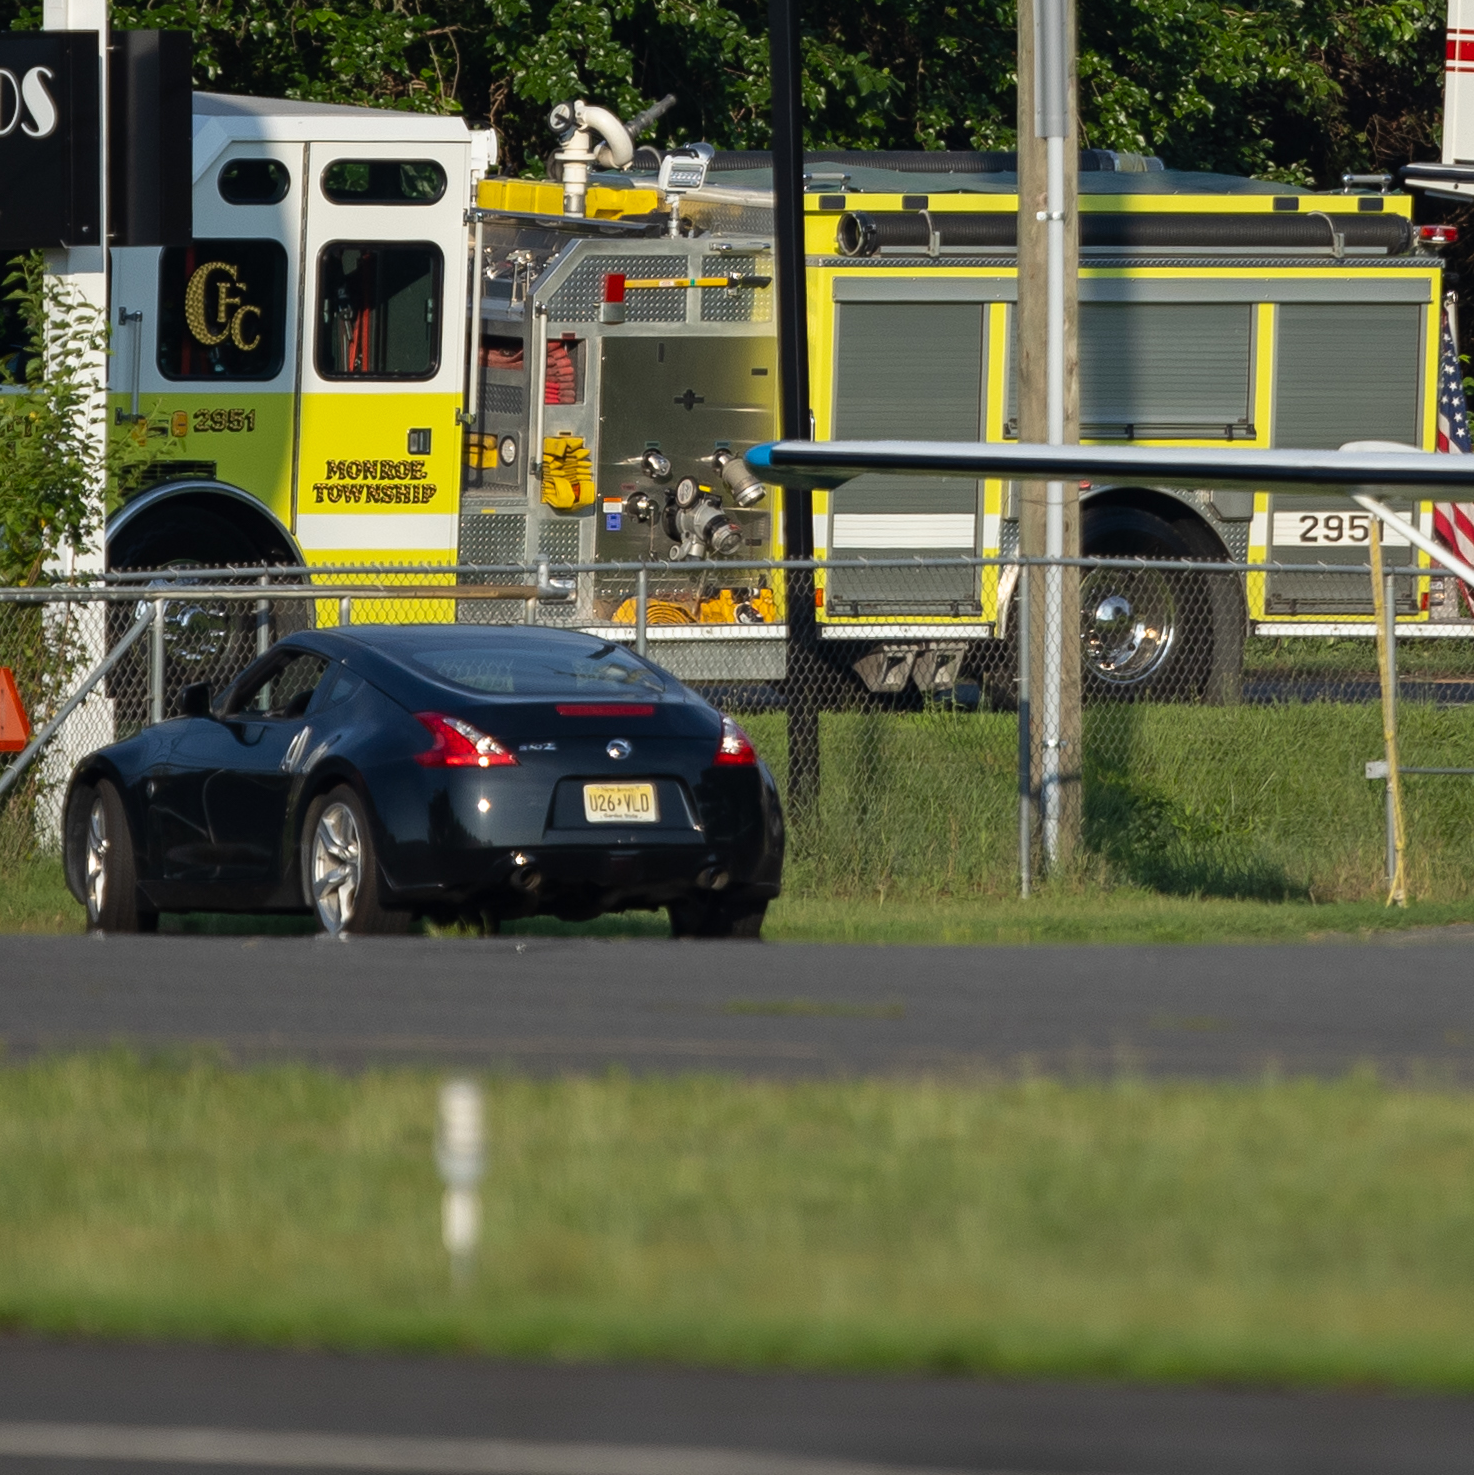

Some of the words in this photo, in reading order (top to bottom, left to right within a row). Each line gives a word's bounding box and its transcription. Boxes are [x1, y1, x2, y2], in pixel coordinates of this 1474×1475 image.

[193, 408, 256, 432] 2951
[325, 459, 428, 480] MONROE
[312, 483, 437, 504] TOWNSHIP
